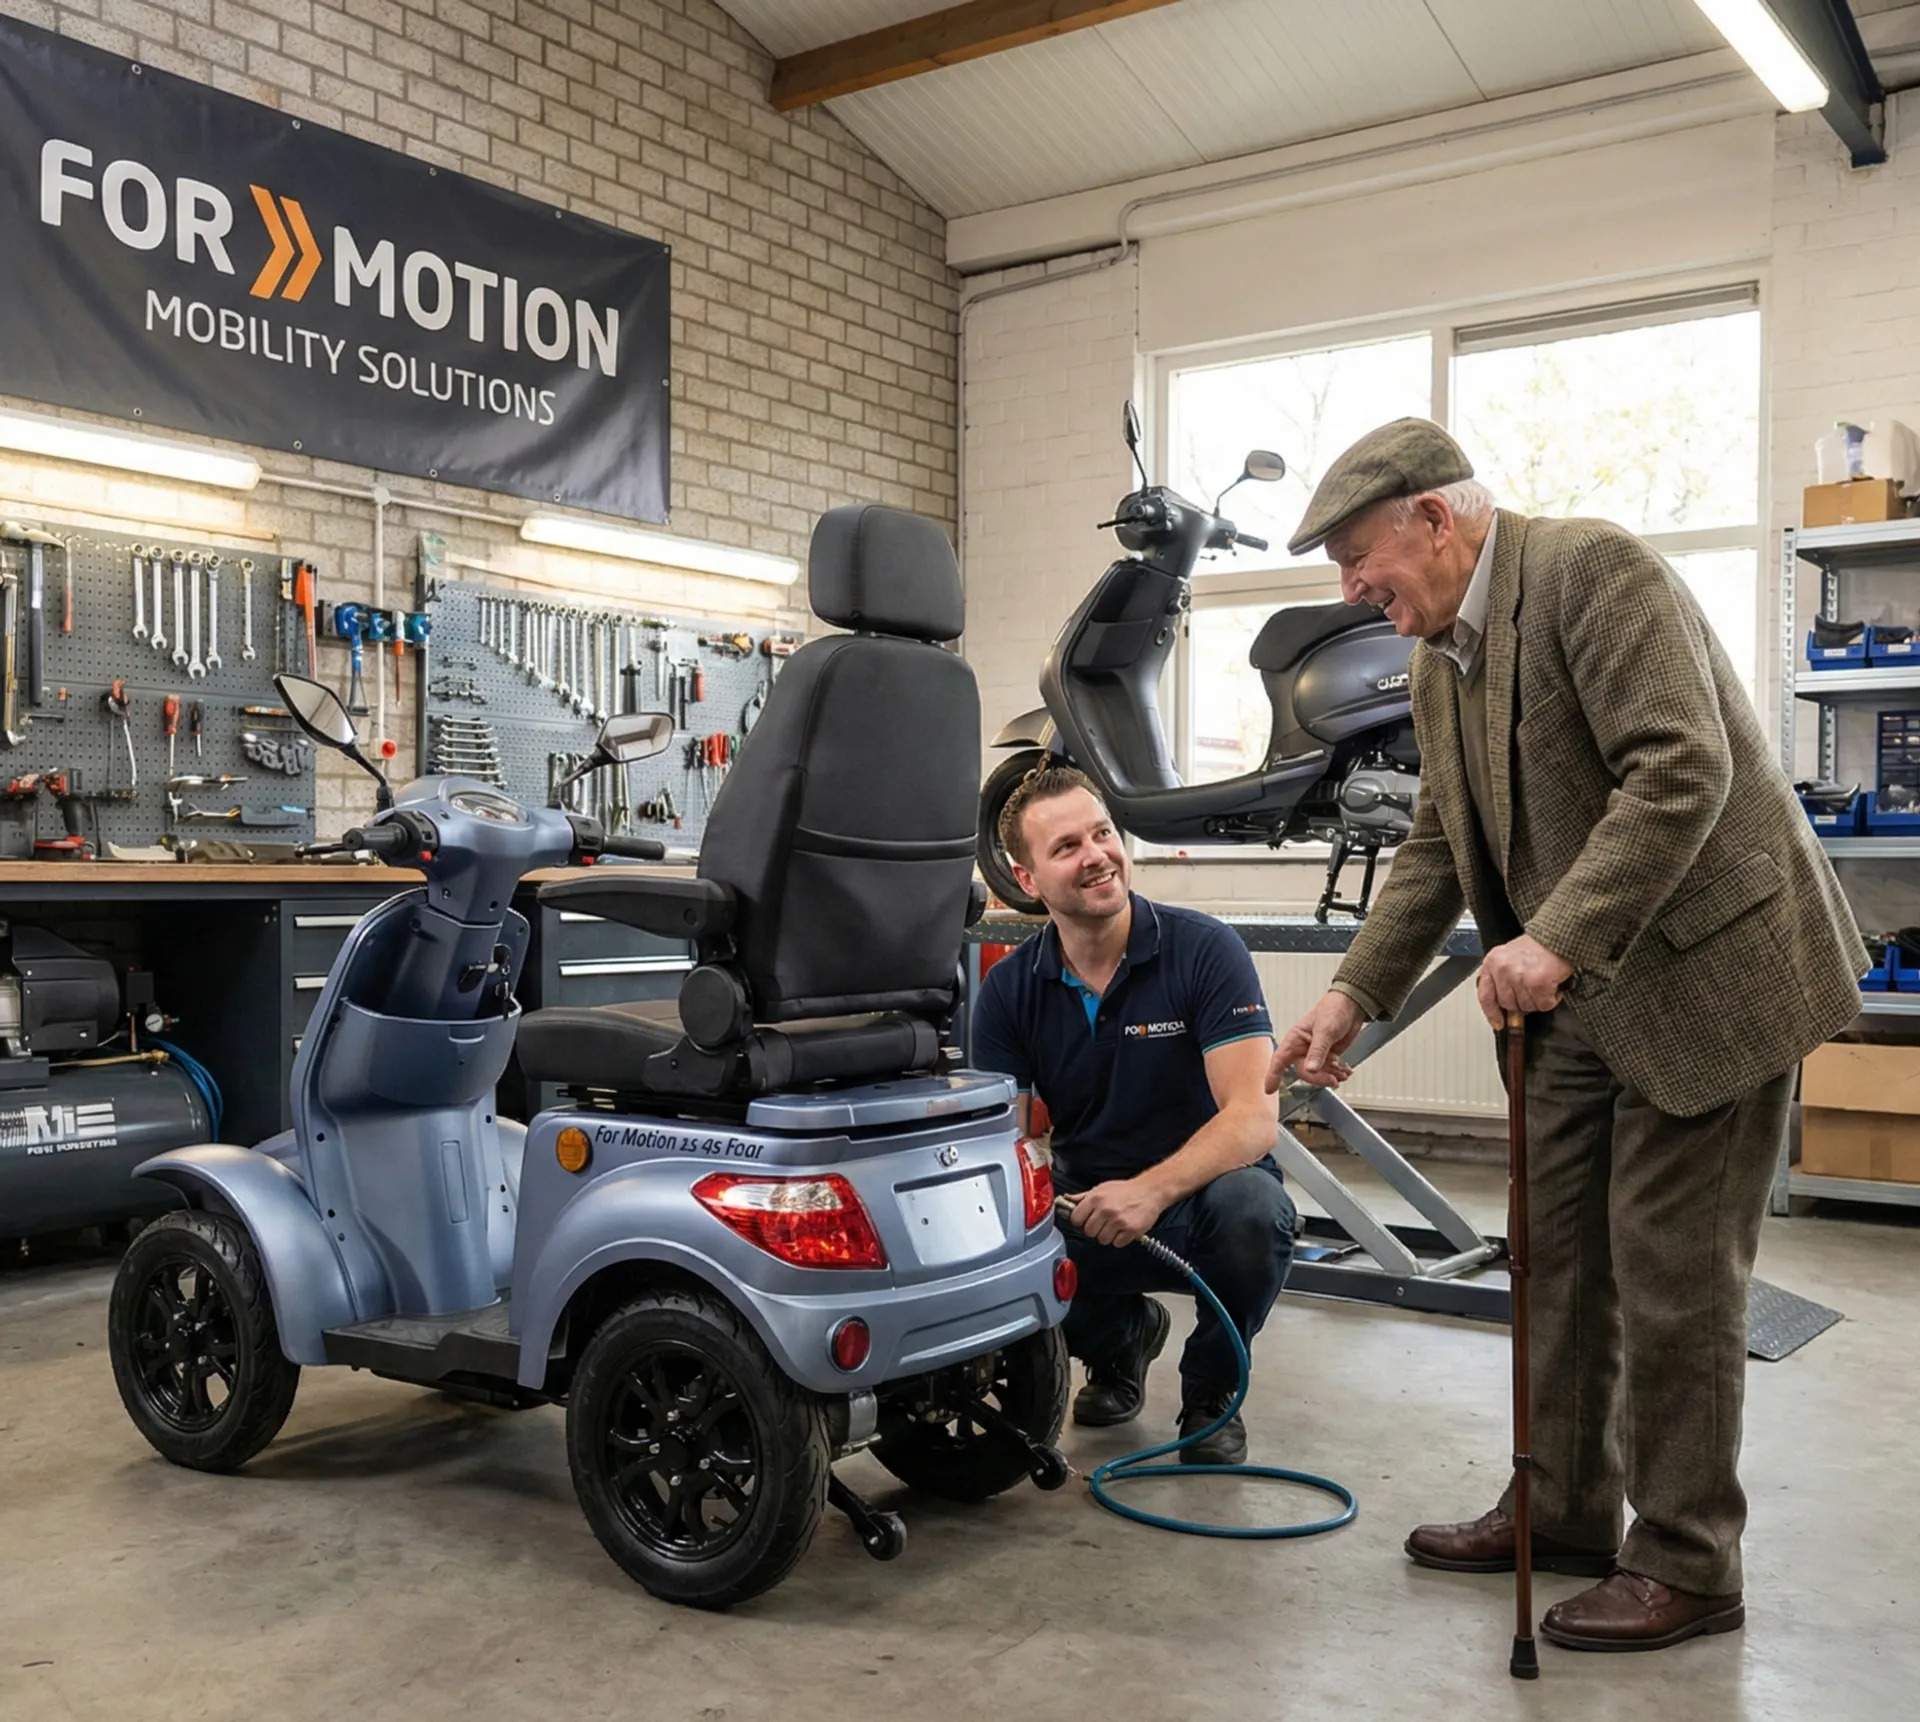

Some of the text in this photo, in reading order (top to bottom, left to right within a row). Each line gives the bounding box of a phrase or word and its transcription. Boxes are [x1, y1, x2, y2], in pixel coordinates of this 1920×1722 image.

[40, 138, 620, 378] FOR MOTION
[145, 289, 557, 426] MOBILITY SOLUTIONS
[595, 1125, 620, 1144] For
[621, 1128, 677, 1150] Motion
